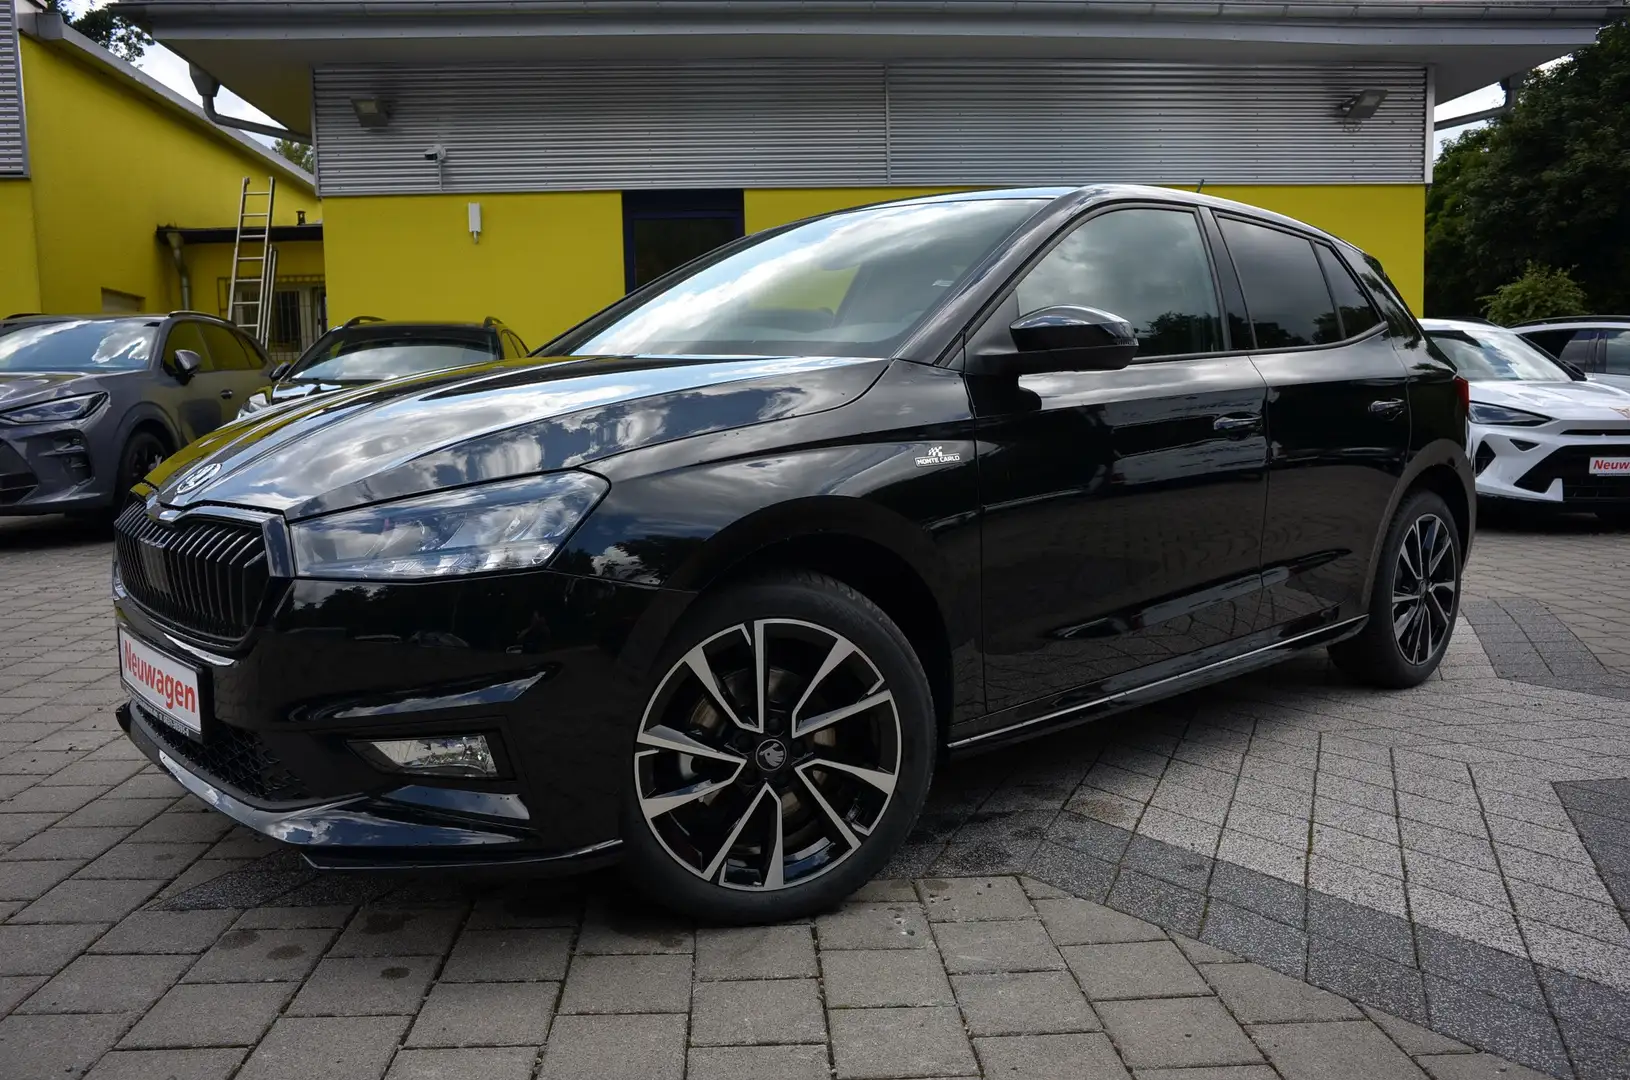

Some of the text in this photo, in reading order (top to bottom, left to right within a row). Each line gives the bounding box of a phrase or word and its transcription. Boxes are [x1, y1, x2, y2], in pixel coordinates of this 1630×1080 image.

[916, 455, 960, 465] MONTE CARLO
[1593, 460, 1630, 470] Neuw
[124, 640, 196, 714] Neuwagen
